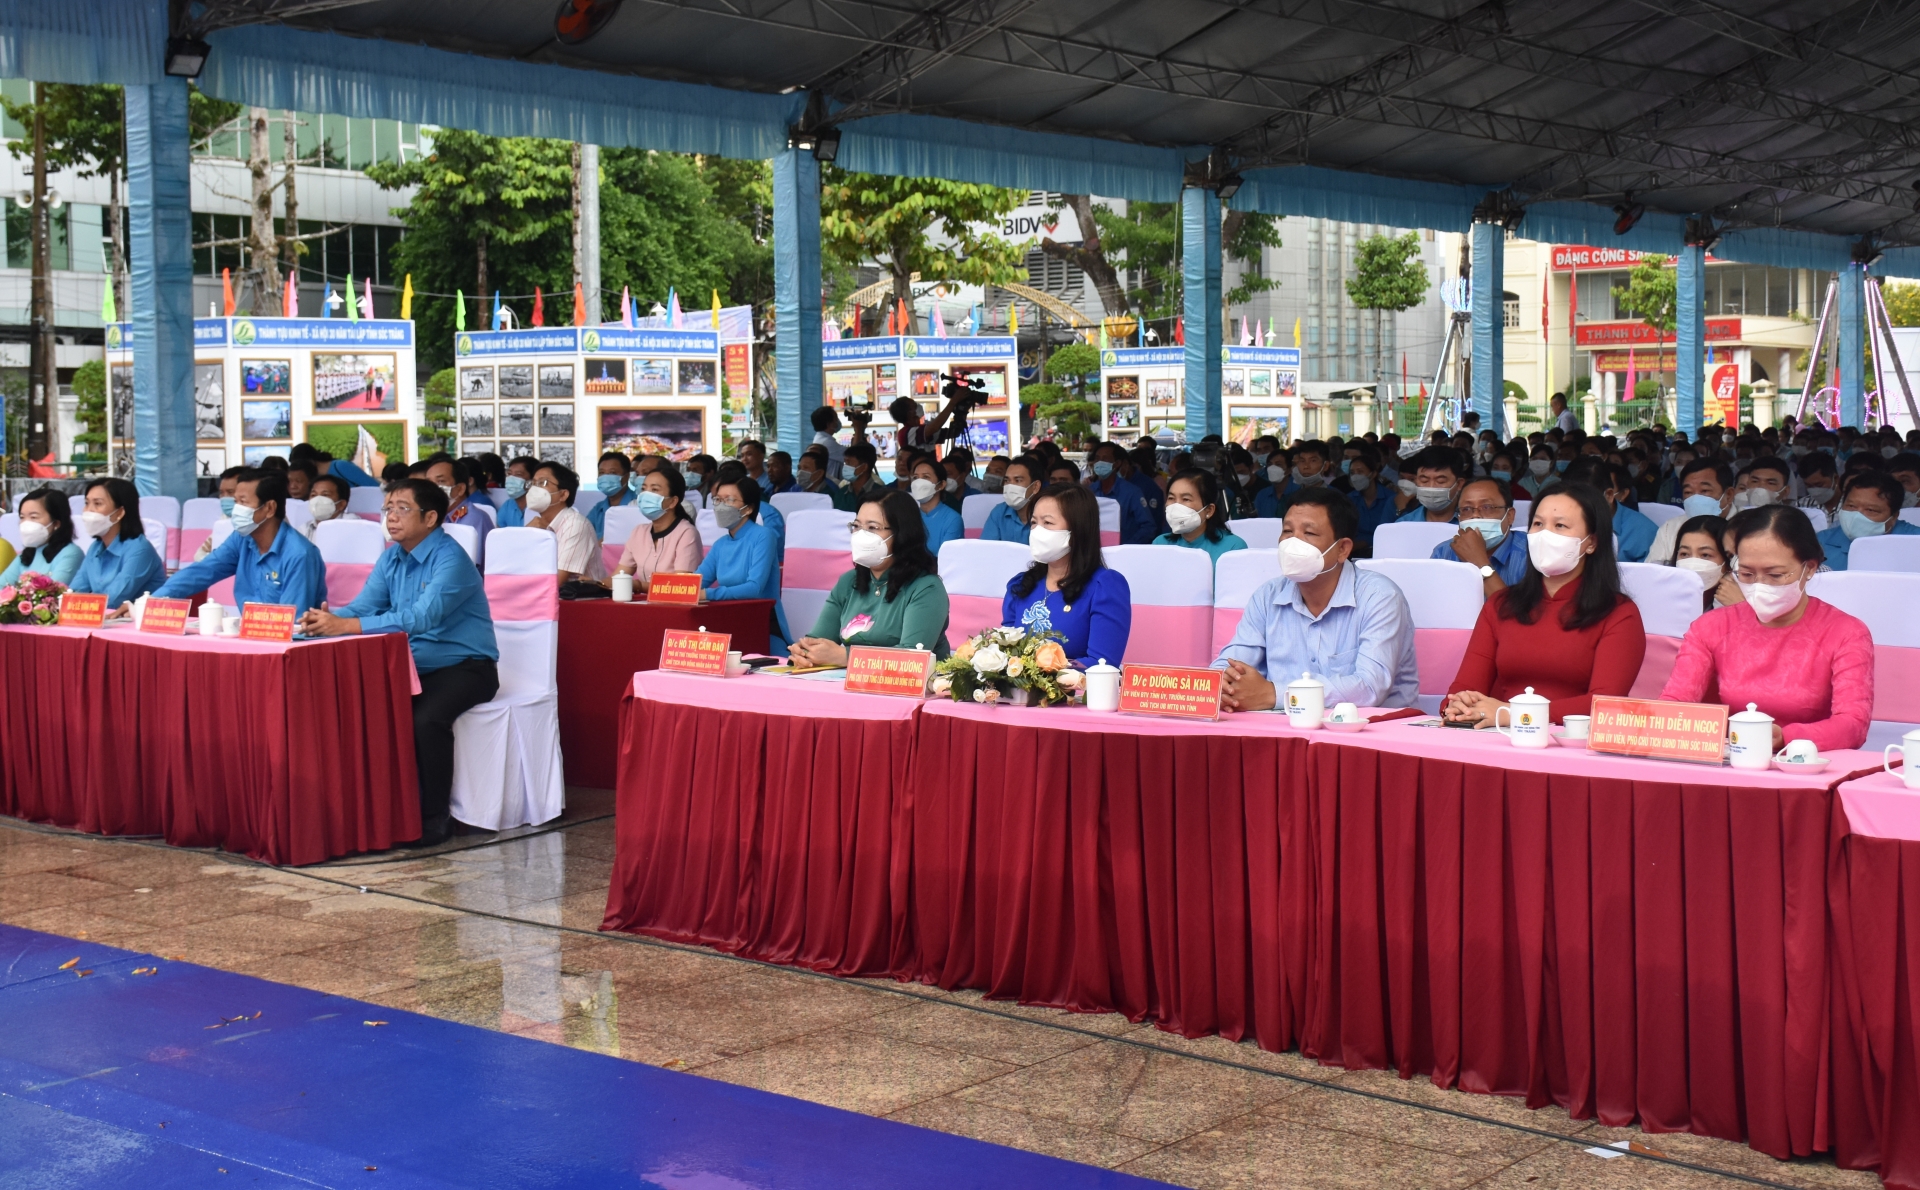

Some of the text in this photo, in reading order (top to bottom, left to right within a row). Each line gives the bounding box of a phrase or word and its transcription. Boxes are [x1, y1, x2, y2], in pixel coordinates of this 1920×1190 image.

[1004, 216, 1041, 235] BIDV
[1556, 248, 1589, 266] ĐẢNG
[1592, 248, 1625, 266] CỘNG
[1586, 325, 1628, 339] THÀNH
[1633, 324, 1649, 338] ỦY
[1717, 383, 1735, 397] 47
[668, 638, 678, 648] Đ/c
[679, 636, 688, 649] HỒ
[688, 640, 698, 652] THỊ
[712, 640, 724, 652] ĐÀO
[853, 656, 923, 673] Đ/c THÁI THU XƯƠNG
[1132, 674, 1211, 691] Đ/c DƯƠNG SÀ KHA
[1598, 711, 1719, 737] Đ/c HUỲNH THỊ DIỄM NGỌC
[1594, 729, 1605, 742] TỈNH
[1606, 730, 1613, 743] ỦY
[1627, 733, 1637, 745] PHÓ
[1638, 733, 1649, 746] CHỦ
[1650, 737, 1661, 749] TỊCH
[1662, 738, 1676, 748] UBND
[1677, 736, 1689, 750] TỈNH
[1690, 738, 1701, 751] SÓC
[1702, 740, 1719, 752] TRĂNG
